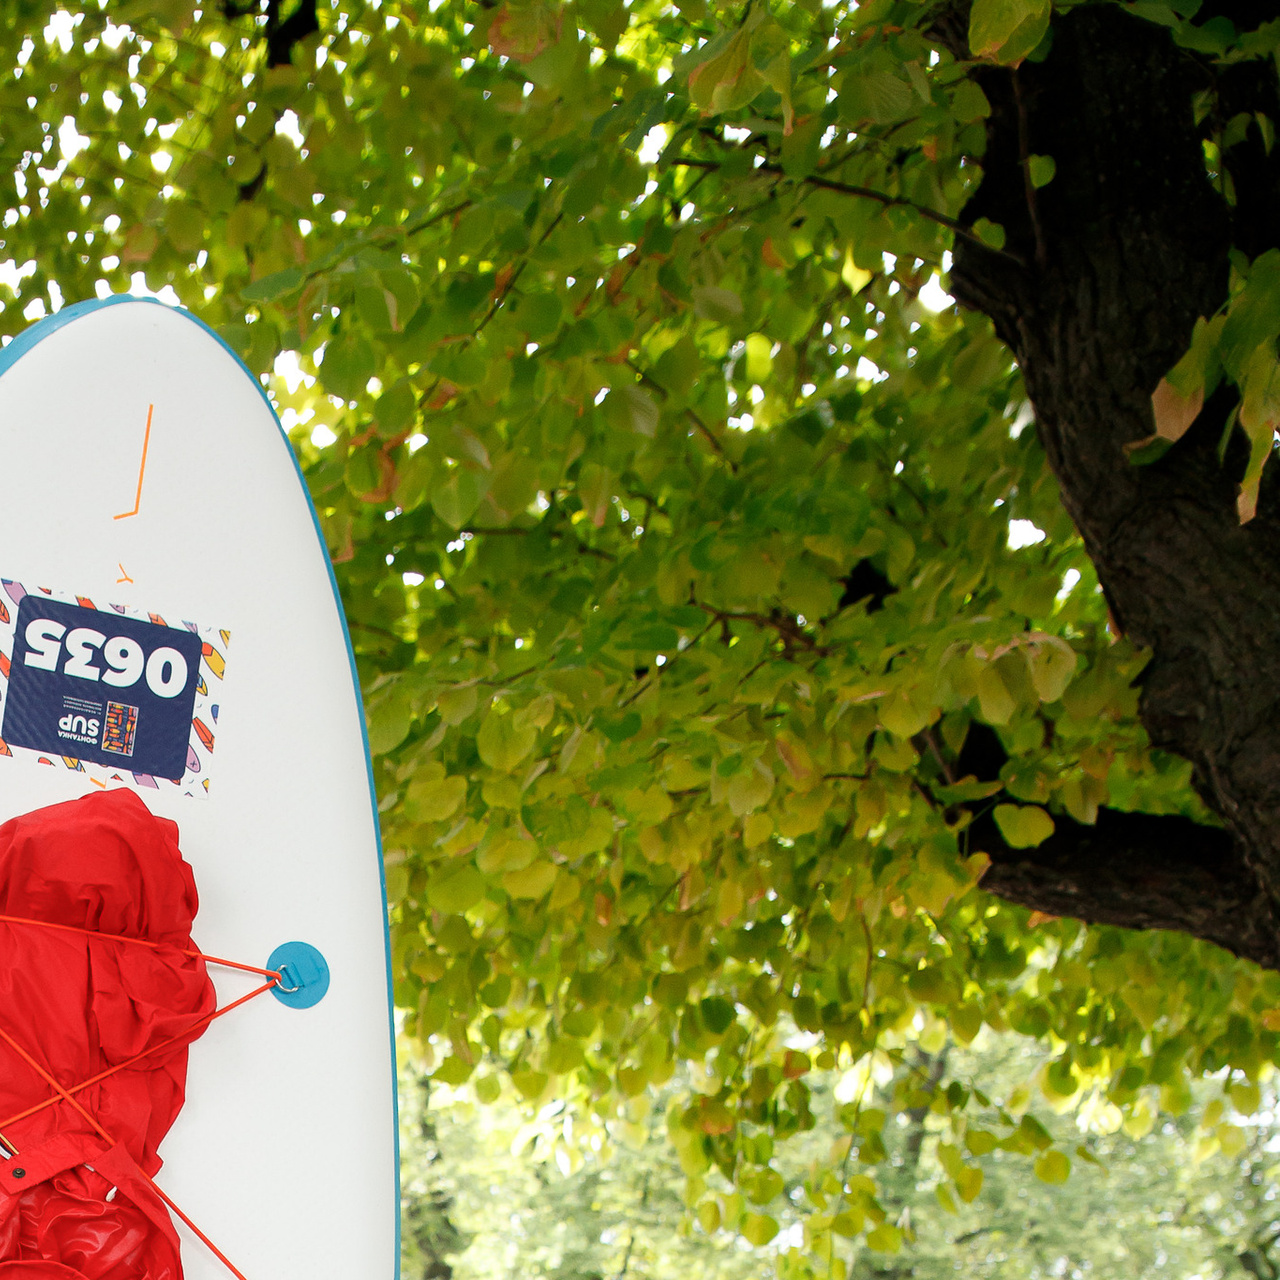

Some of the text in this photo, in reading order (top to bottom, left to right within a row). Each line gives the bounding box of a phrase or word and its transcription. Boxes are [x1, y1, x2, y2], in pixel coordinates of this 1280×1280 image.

[24, 618, 188, 699] 0635
[59, 713, 100, 737] SUP
[57, 730, 98, 745] ФОНТАНКА
